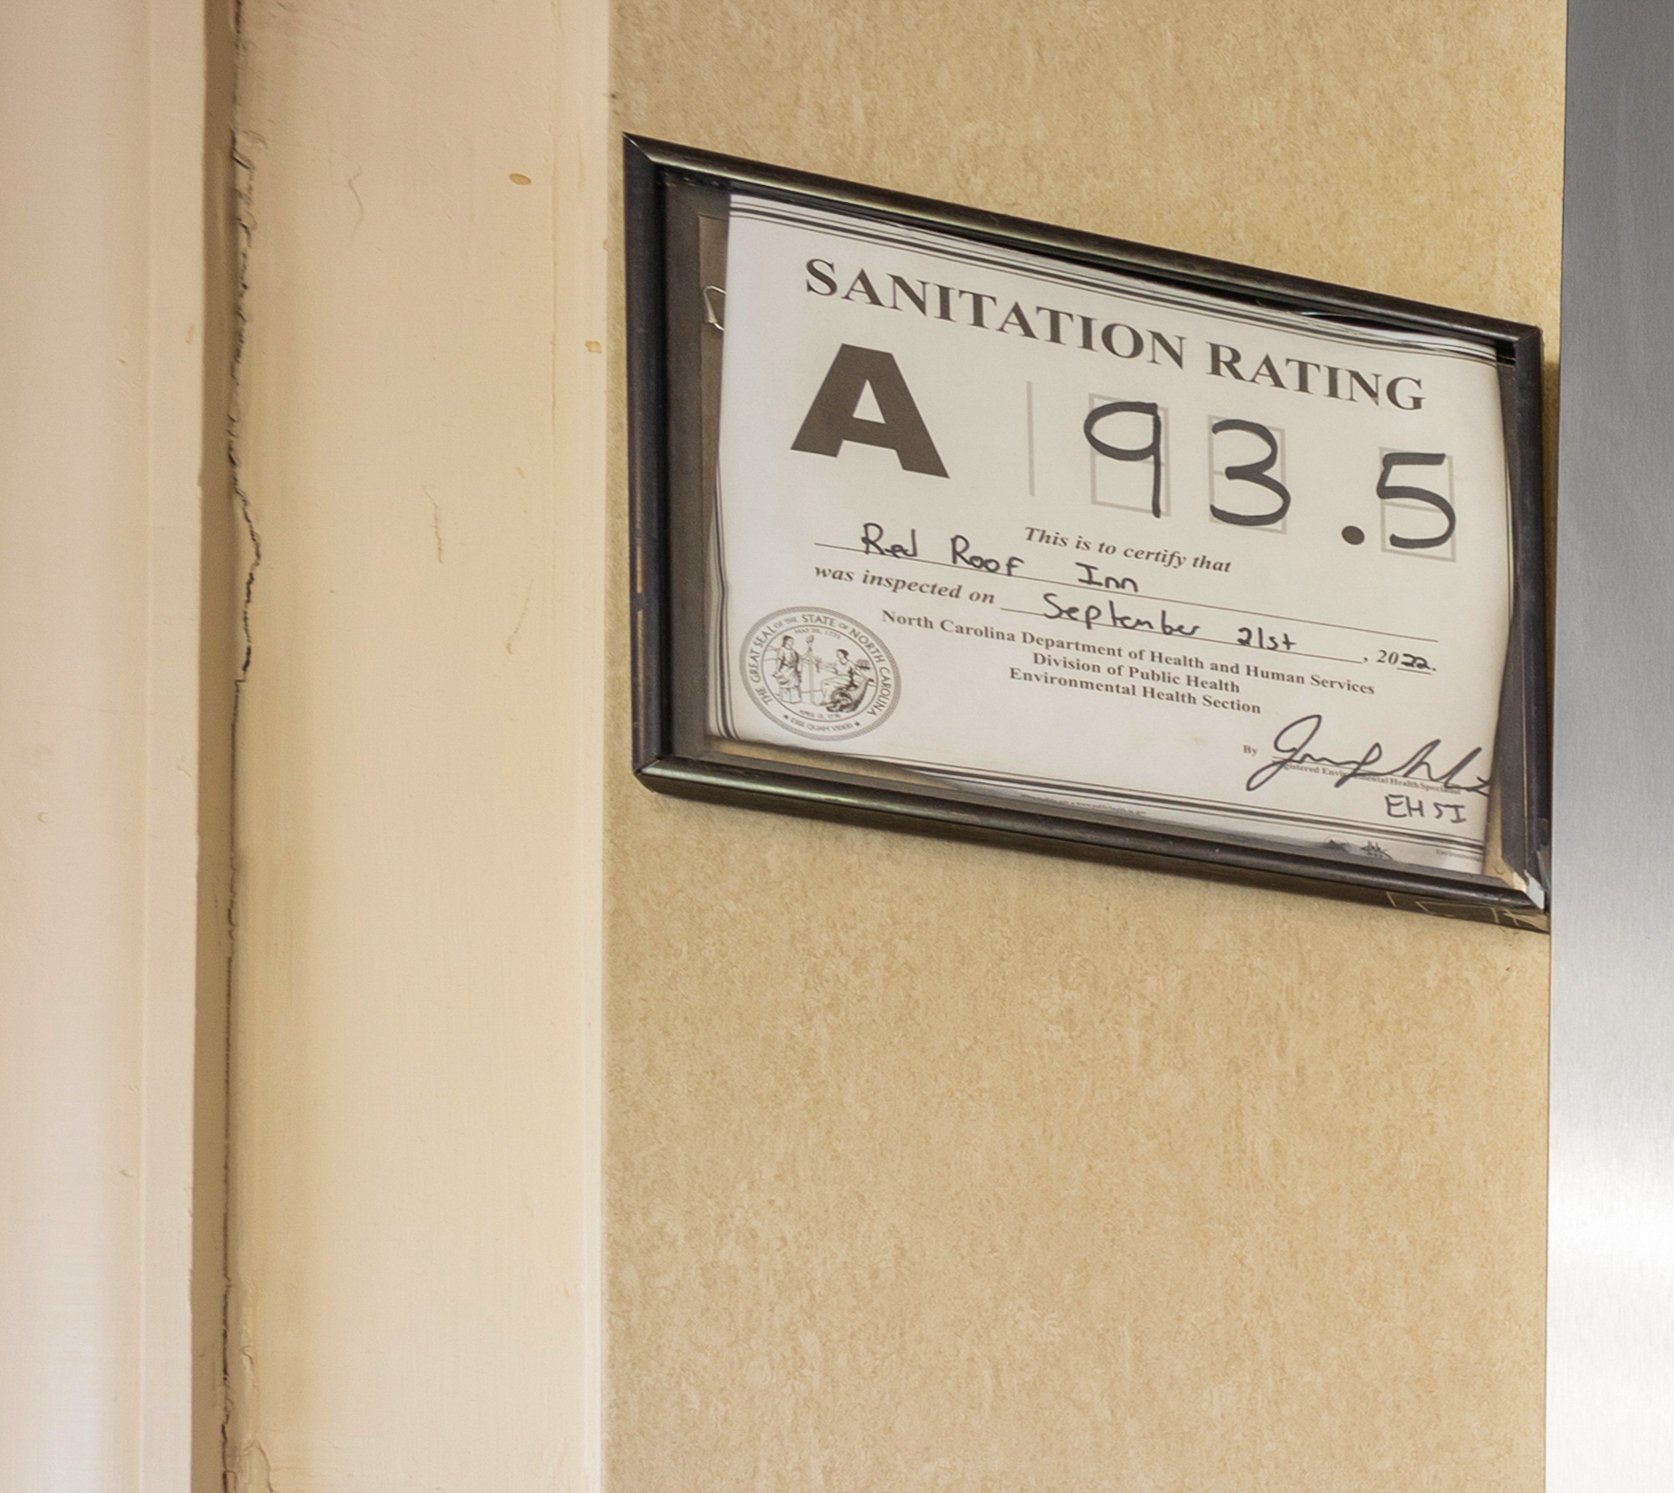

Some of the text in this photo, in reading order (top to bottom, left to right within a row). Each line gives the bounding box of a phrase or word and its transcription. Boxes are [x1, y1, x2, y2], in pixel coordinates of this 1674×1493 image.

[805, 258, 1425, 410] SANITATION RATING
[790, 343, 950, 479] A
[861, 522, 1139, 593] Red Roof Inn
[1025, 526, 1232, 573] This is to certify that
[801, 613, 836, 627] STATE
[814, 565, 854, 583] was
[862, 568, 962, 600] inspected
[968, 590, 995, 605] on
[1042, 592, 1200, 635] September
[1236, 626, 1297, 650] 21st
[753, 625, 776, 647] SEAL
[850, 627, 886, 664] NORTH
[881, 608, 1375, 696] North Carolina Department of Health and Human Services
[748, 648, 761, 683] GREAT
[1033, 652, 1241, 695] Division of Public Health
[867, 667, 892, 717] CAROLINA
[1009, 666, 1262, 715] Environmental Health Section
[1243, 745, 1258, 757] By
